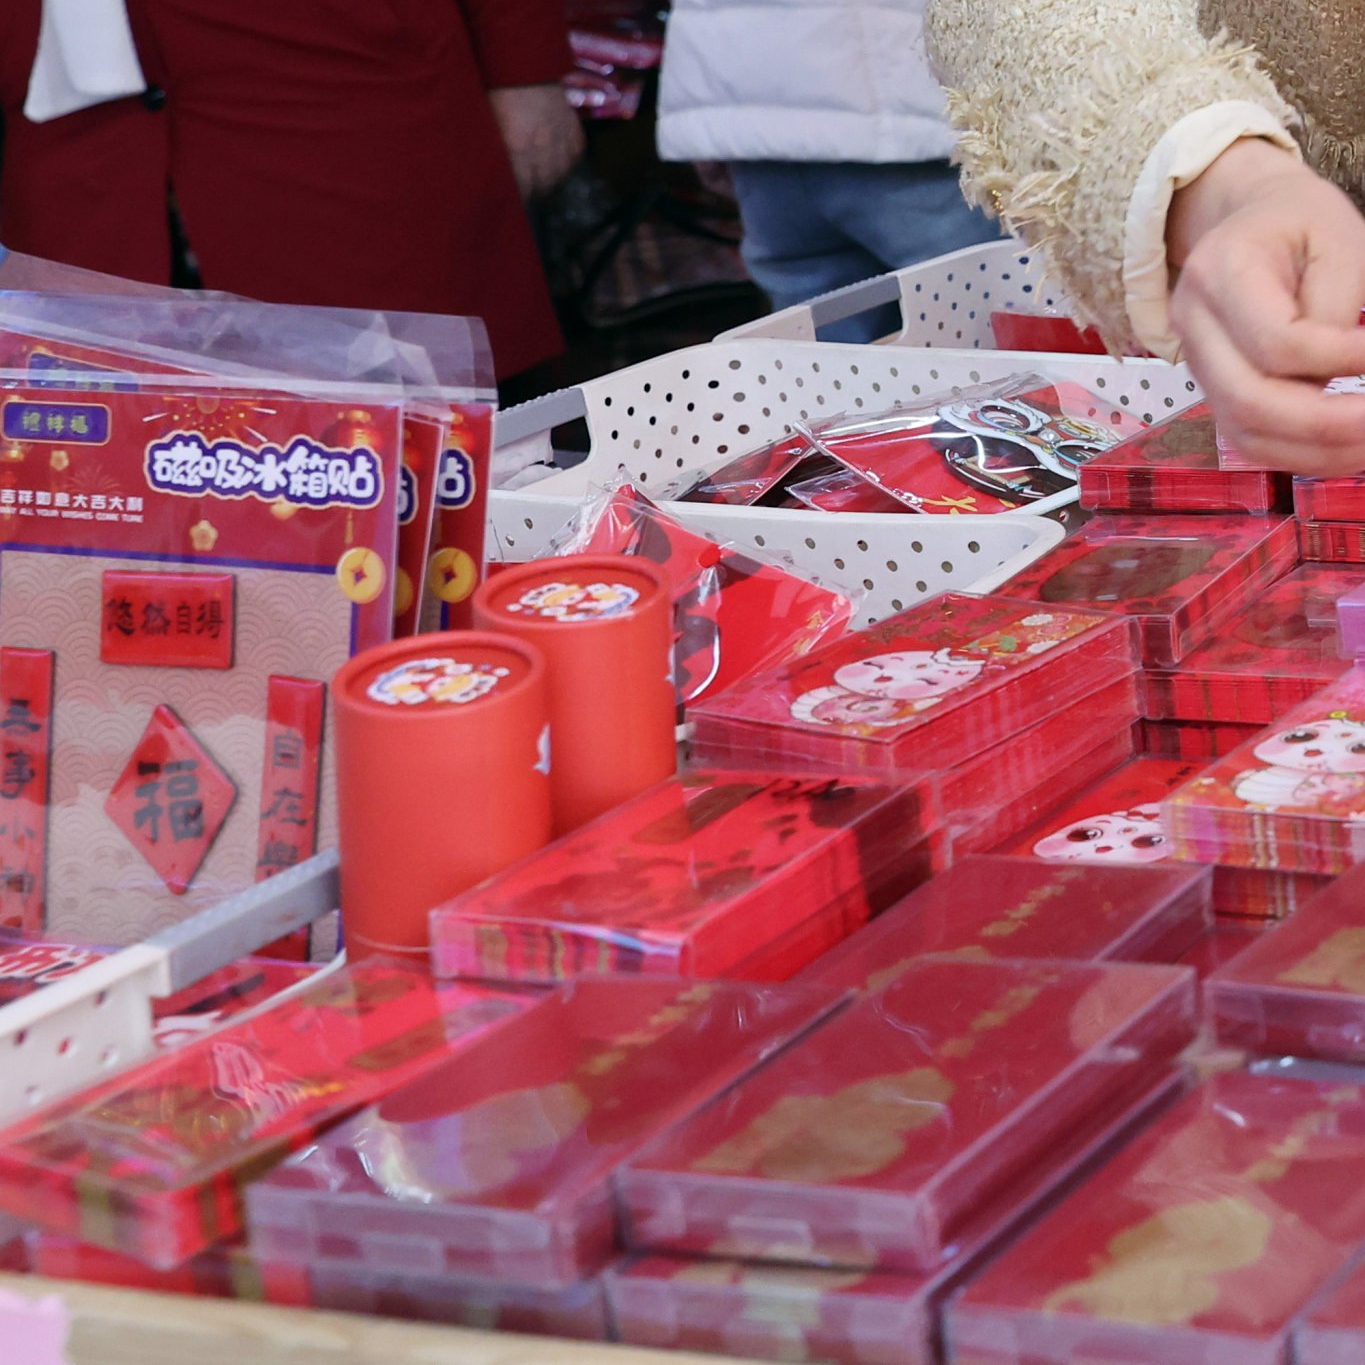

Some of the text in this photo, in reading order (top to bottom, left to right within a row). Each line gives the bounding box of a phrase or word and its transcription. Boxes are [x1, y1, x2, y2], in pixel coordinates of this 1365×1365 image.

[152, 439, 375, 500] 磁吸冰箱贴
[105, 596, 225, 640] 悠然自得
[133, 759, 206, 845] 福
